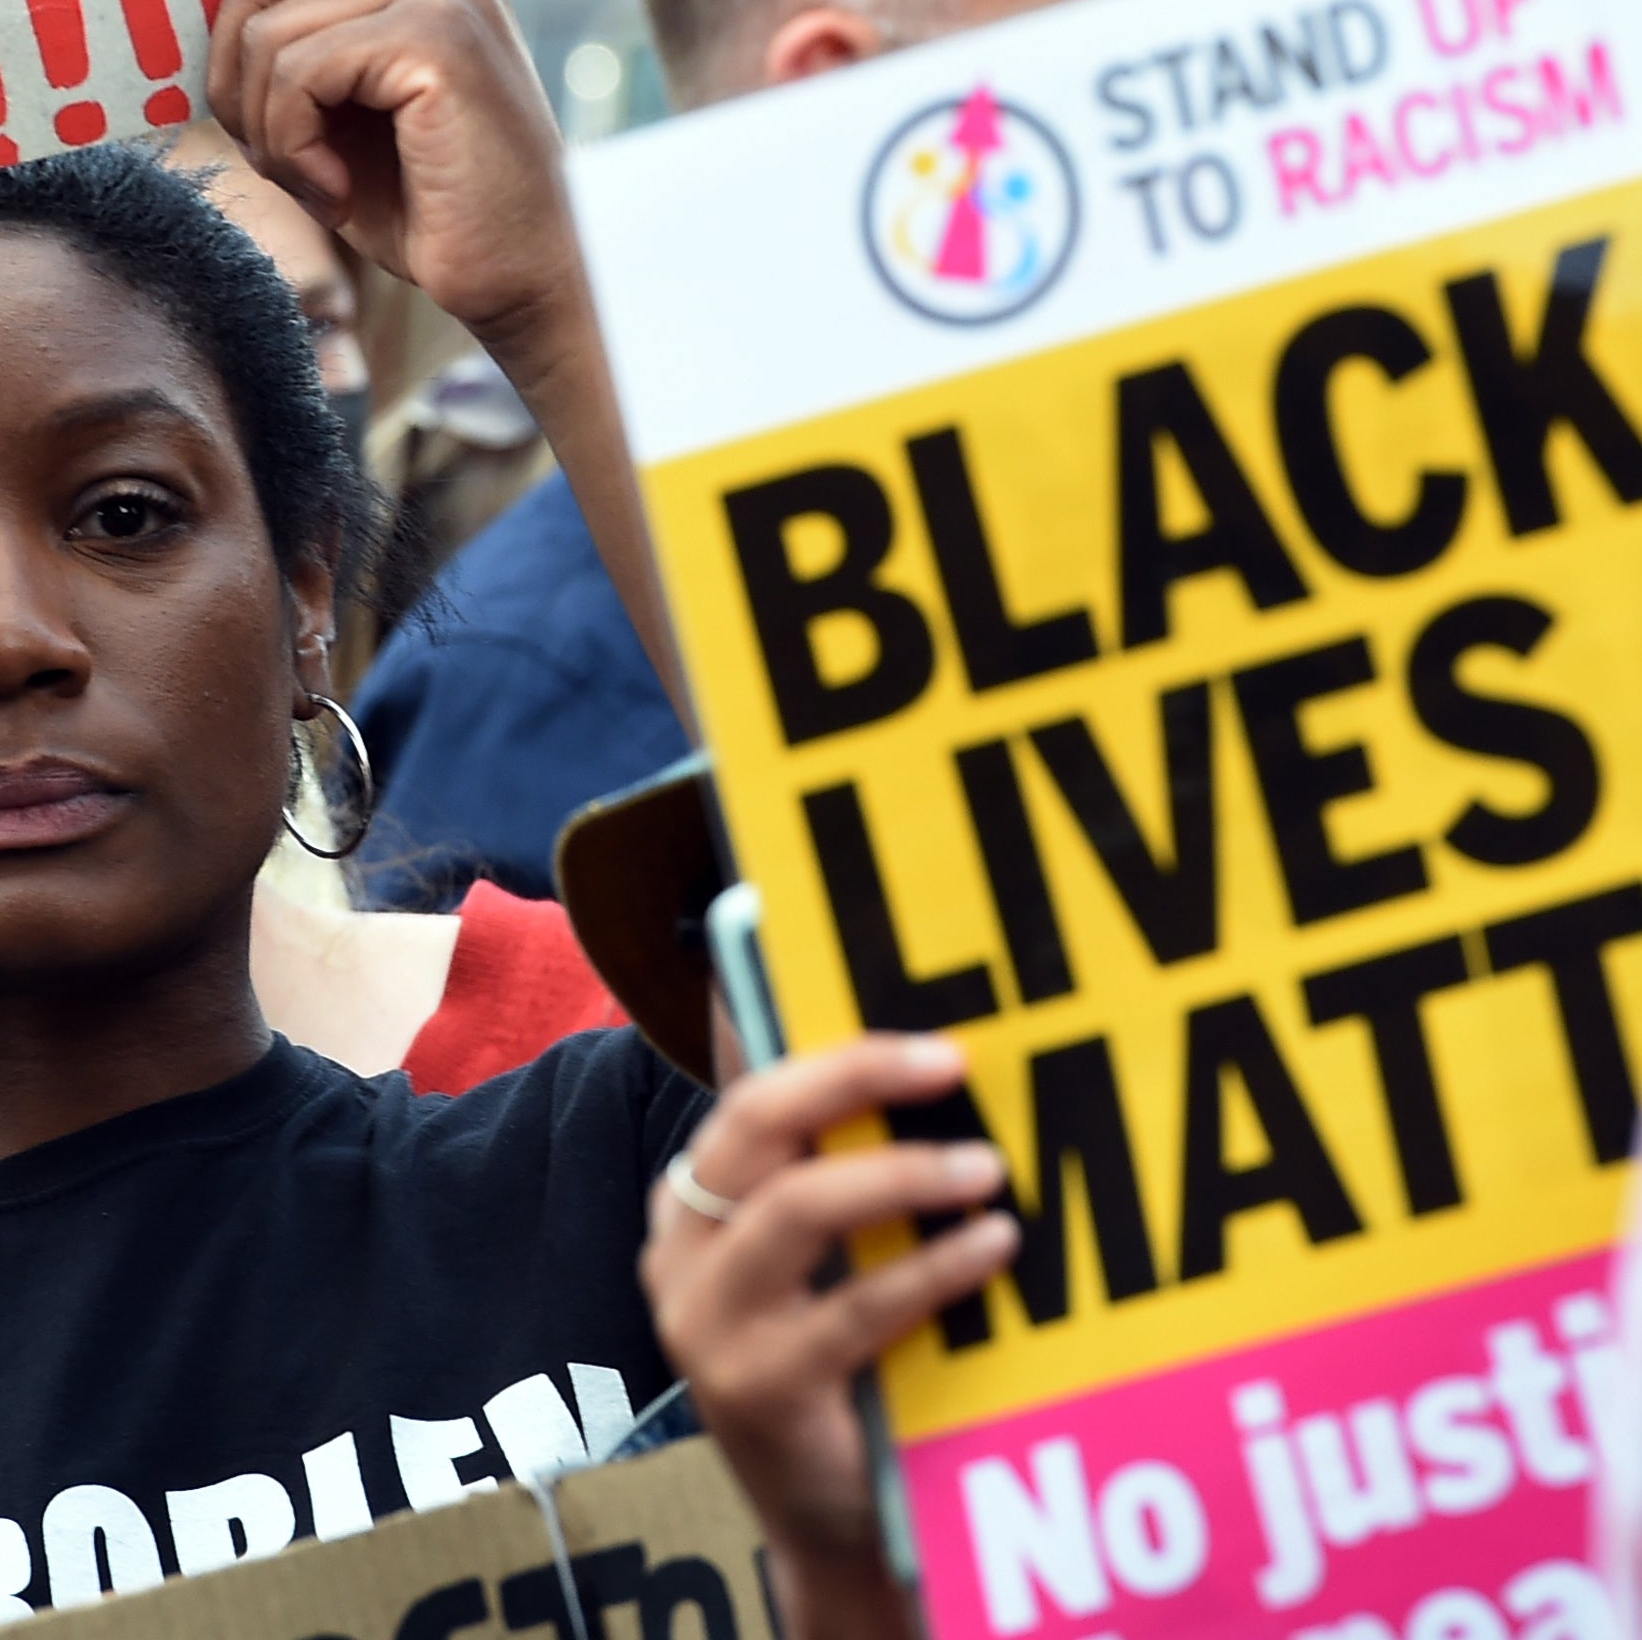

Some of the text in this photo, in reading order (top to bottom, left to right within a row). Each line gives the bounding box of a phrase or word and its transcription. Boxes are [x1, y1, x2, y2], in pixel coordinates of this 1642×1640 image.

[1115, 38, 1625, 258] TO RACISM
[797, 588, 1606, 1038] LIVES
[959, 1290, 1617, 1638] No justi
